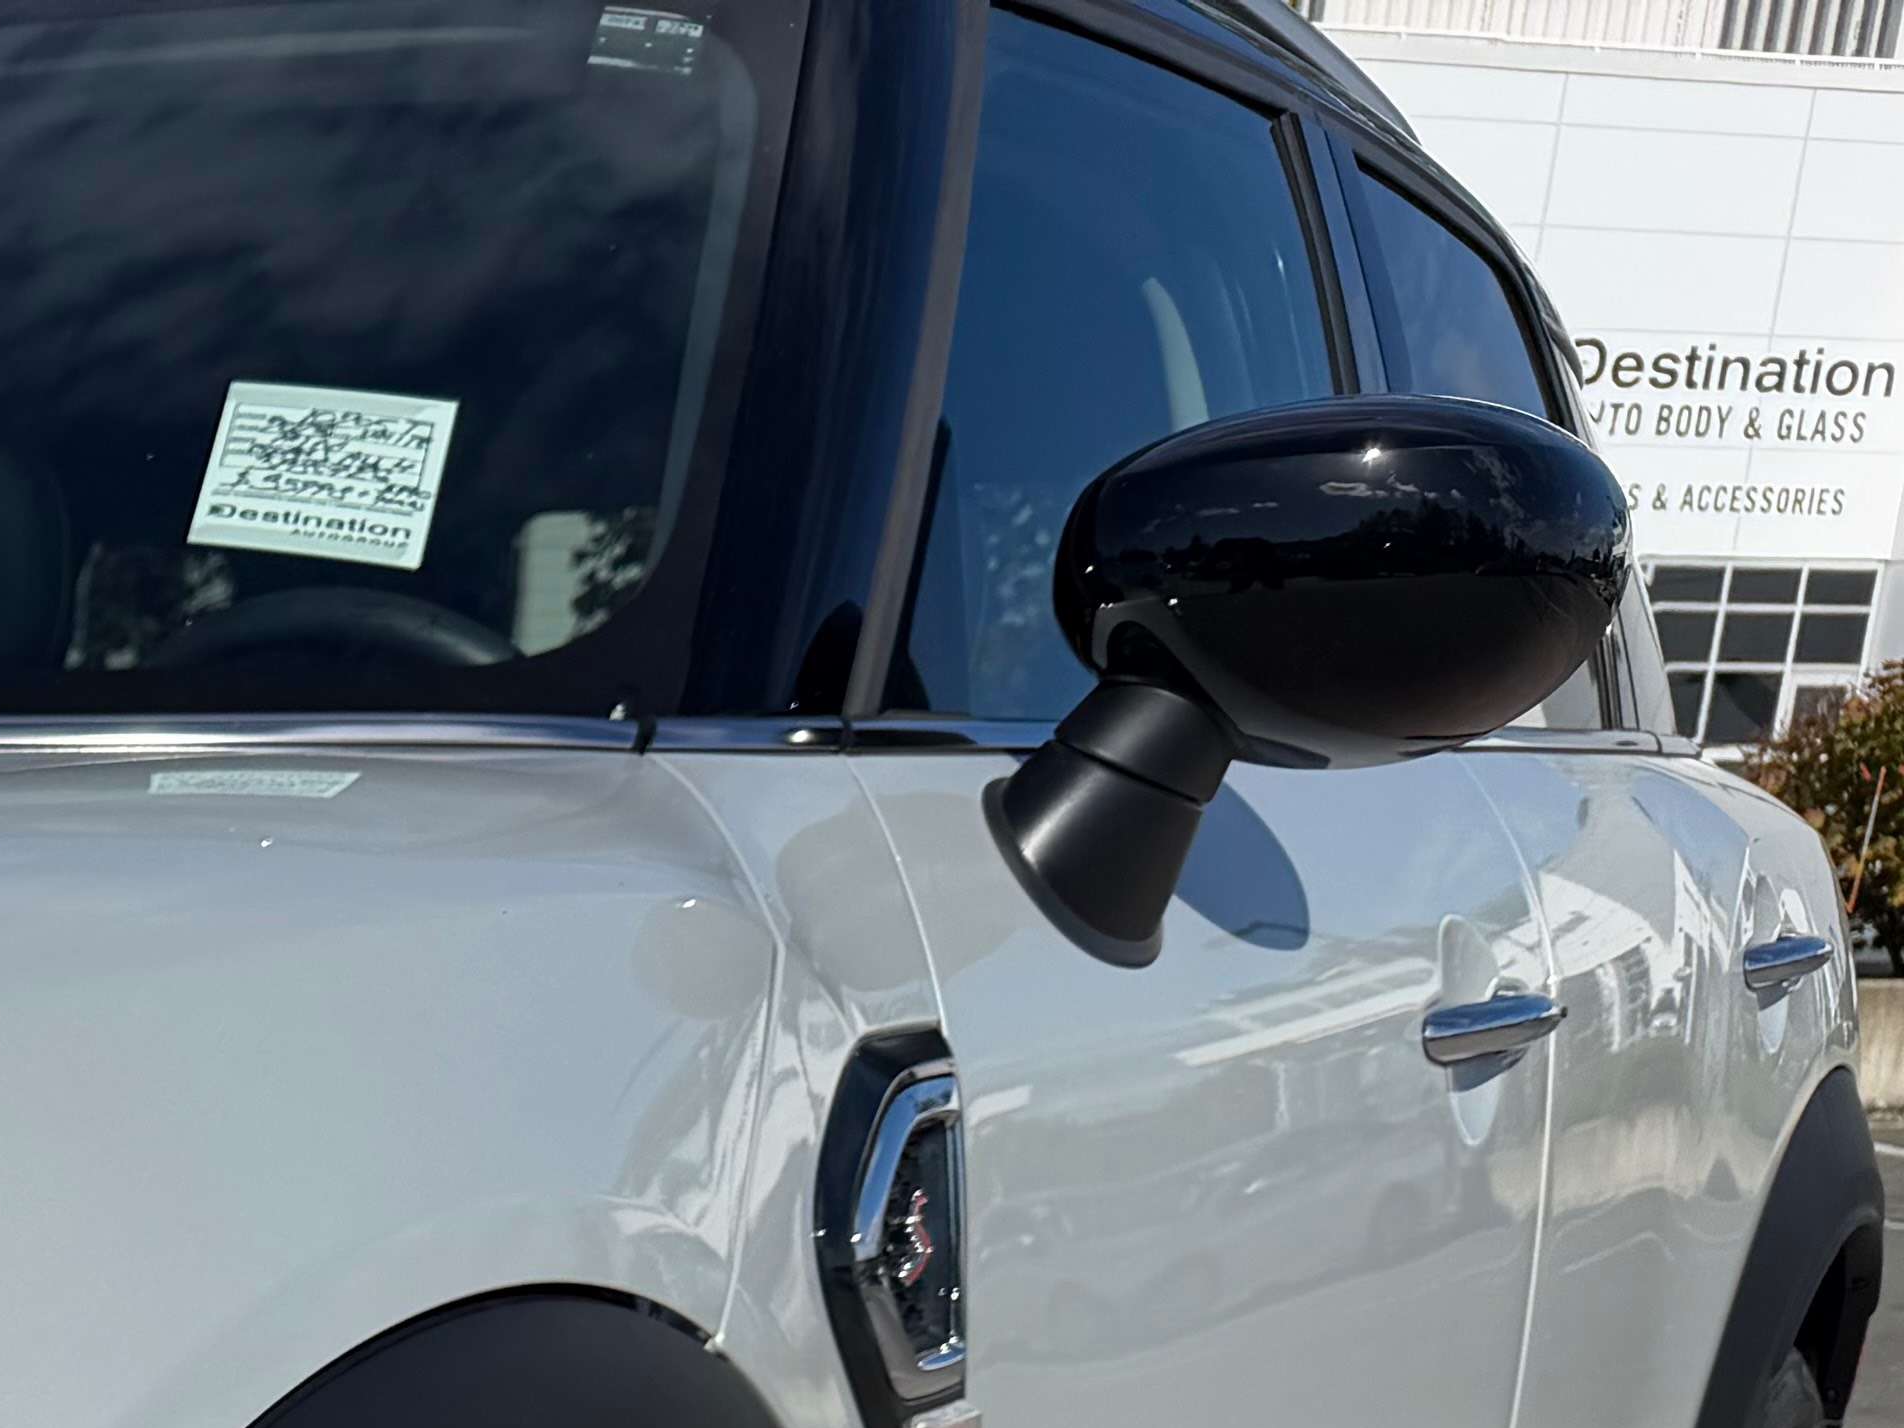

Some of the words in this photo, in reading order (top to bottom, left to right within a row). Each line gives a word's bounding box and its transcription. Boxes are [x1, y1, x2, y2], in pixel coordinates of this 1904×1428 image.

[1574, 337, 1896, 398] Destination
[1655, 404, 1733, 439] BODY
[1744, 407, 1761, 440] &
[1777, 408, 1867, 443] GLASS
[1652, 483, 1667, 511] &
[1680, 484, 1846, 516] ACCESSORIES
[207, 503, 412, 540] Destination
